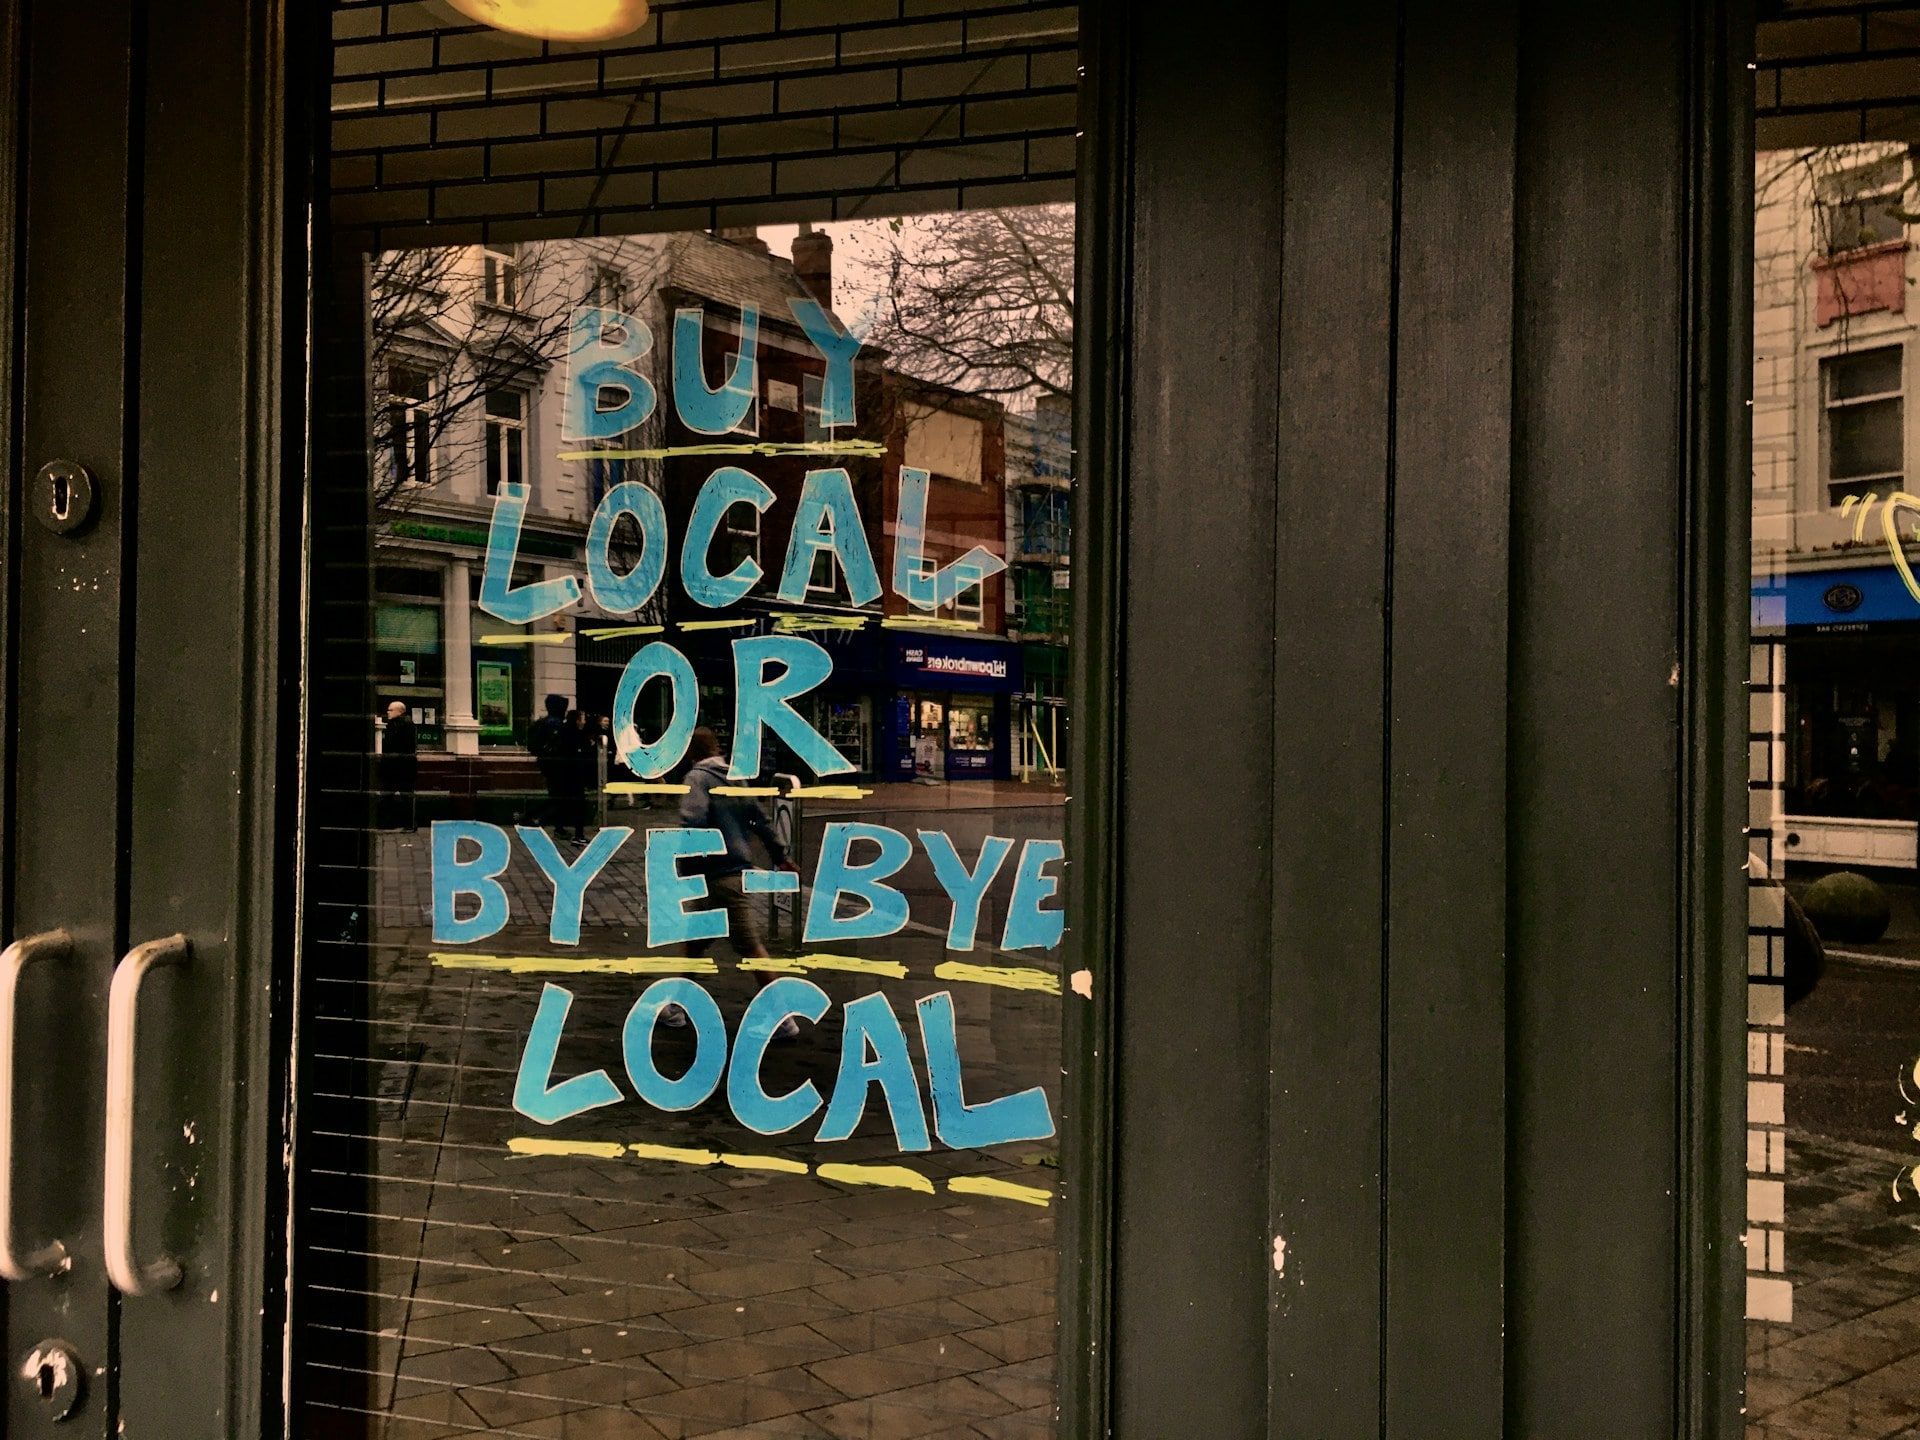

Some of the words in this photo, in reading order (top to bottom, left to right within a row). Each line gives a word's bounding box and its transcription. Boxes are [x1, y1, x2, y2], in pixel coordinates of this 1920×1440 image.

[561, 296, 878, 441] BUY
[479, 466, 1008, 625] LOCAL
[612, 636, 856, 780] OR
[431, 819, 1065, 951] BYE-BYE
[512, 977, 1056, 1152] LOCAL
